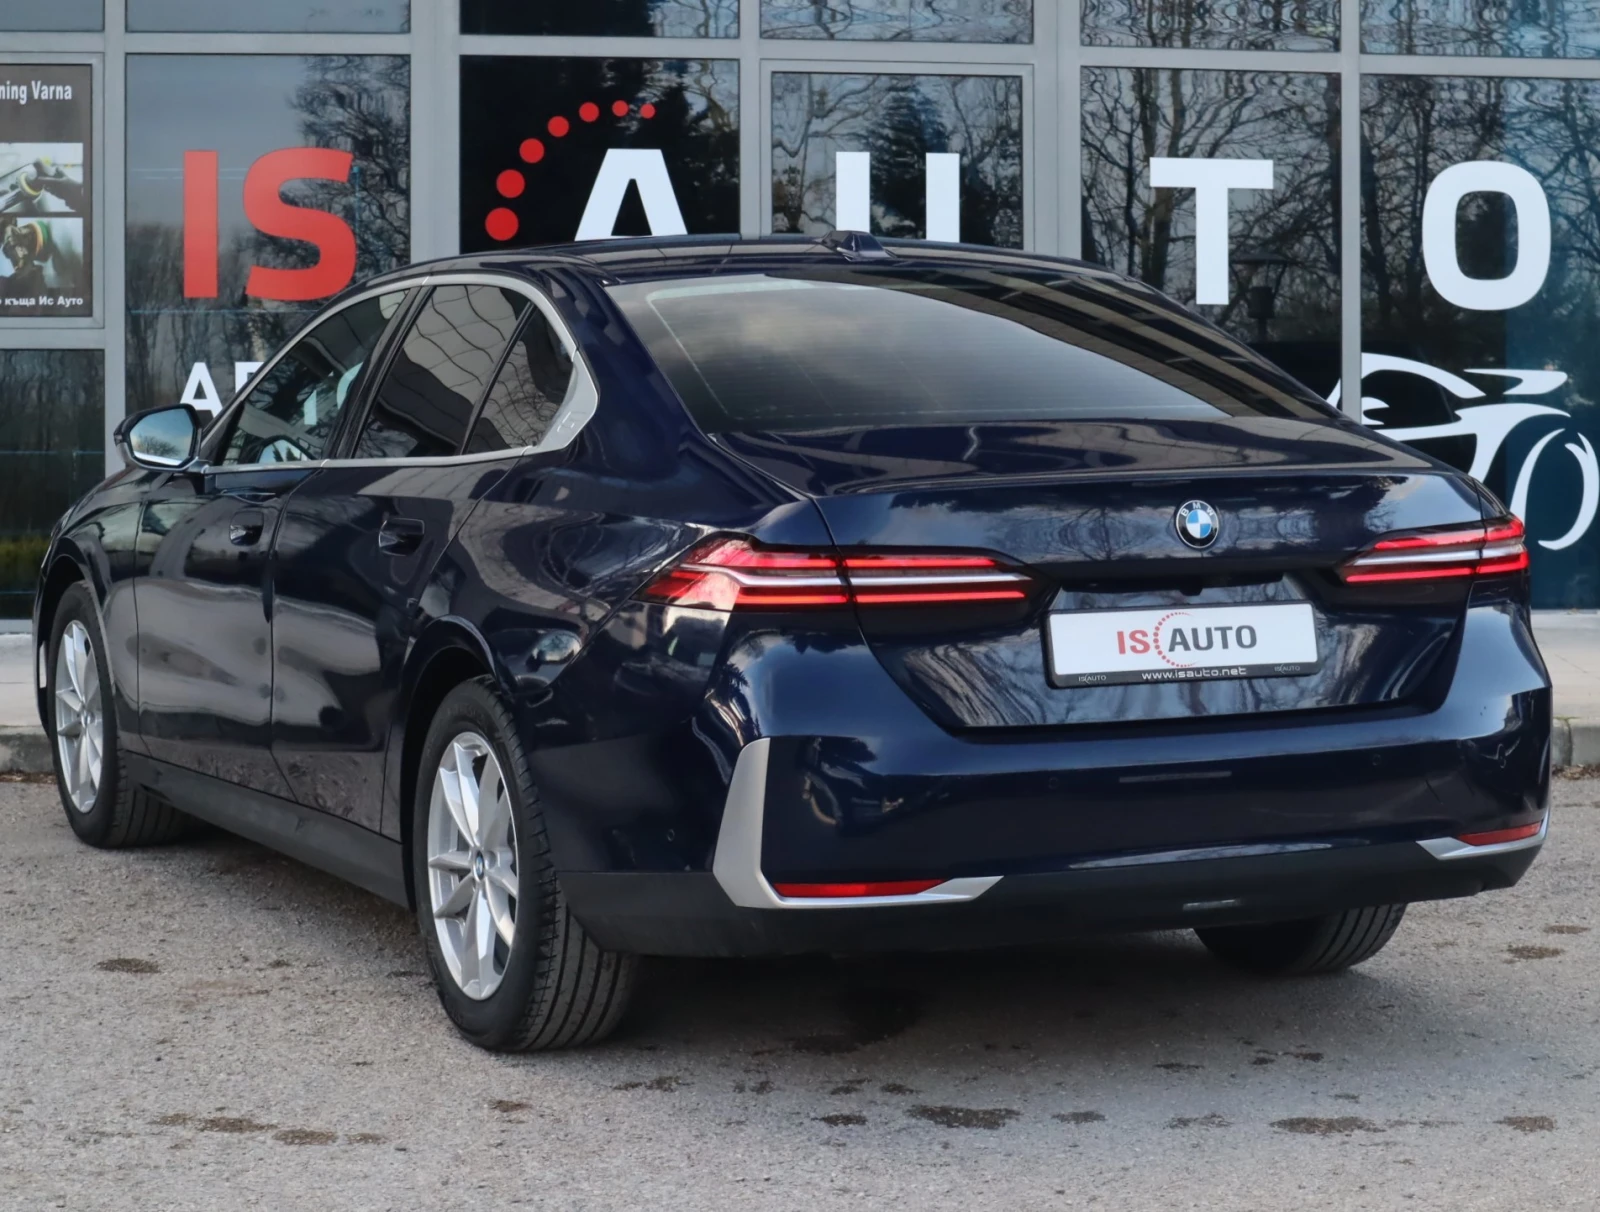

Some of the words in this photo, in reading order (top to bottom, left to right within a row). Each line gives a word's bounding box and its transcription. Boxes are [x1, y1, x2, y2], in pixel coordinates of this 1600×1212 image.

[0, 80, 28, 105] ning
[31, 80, 73, 100] Varna
[183, 146, 357, 301] IS
[4, 296, 36, 307] къща
[39, 295, 54, 306] Ис
[57, 295, 84, 308] Ауто
[1180, 502, 1215, 517] BMW
[1117, 629, 1151, 655] IS
[1168, 624, 1257, 652] AUTO
[1141, 666, 1247, 681] www.isauto.net
